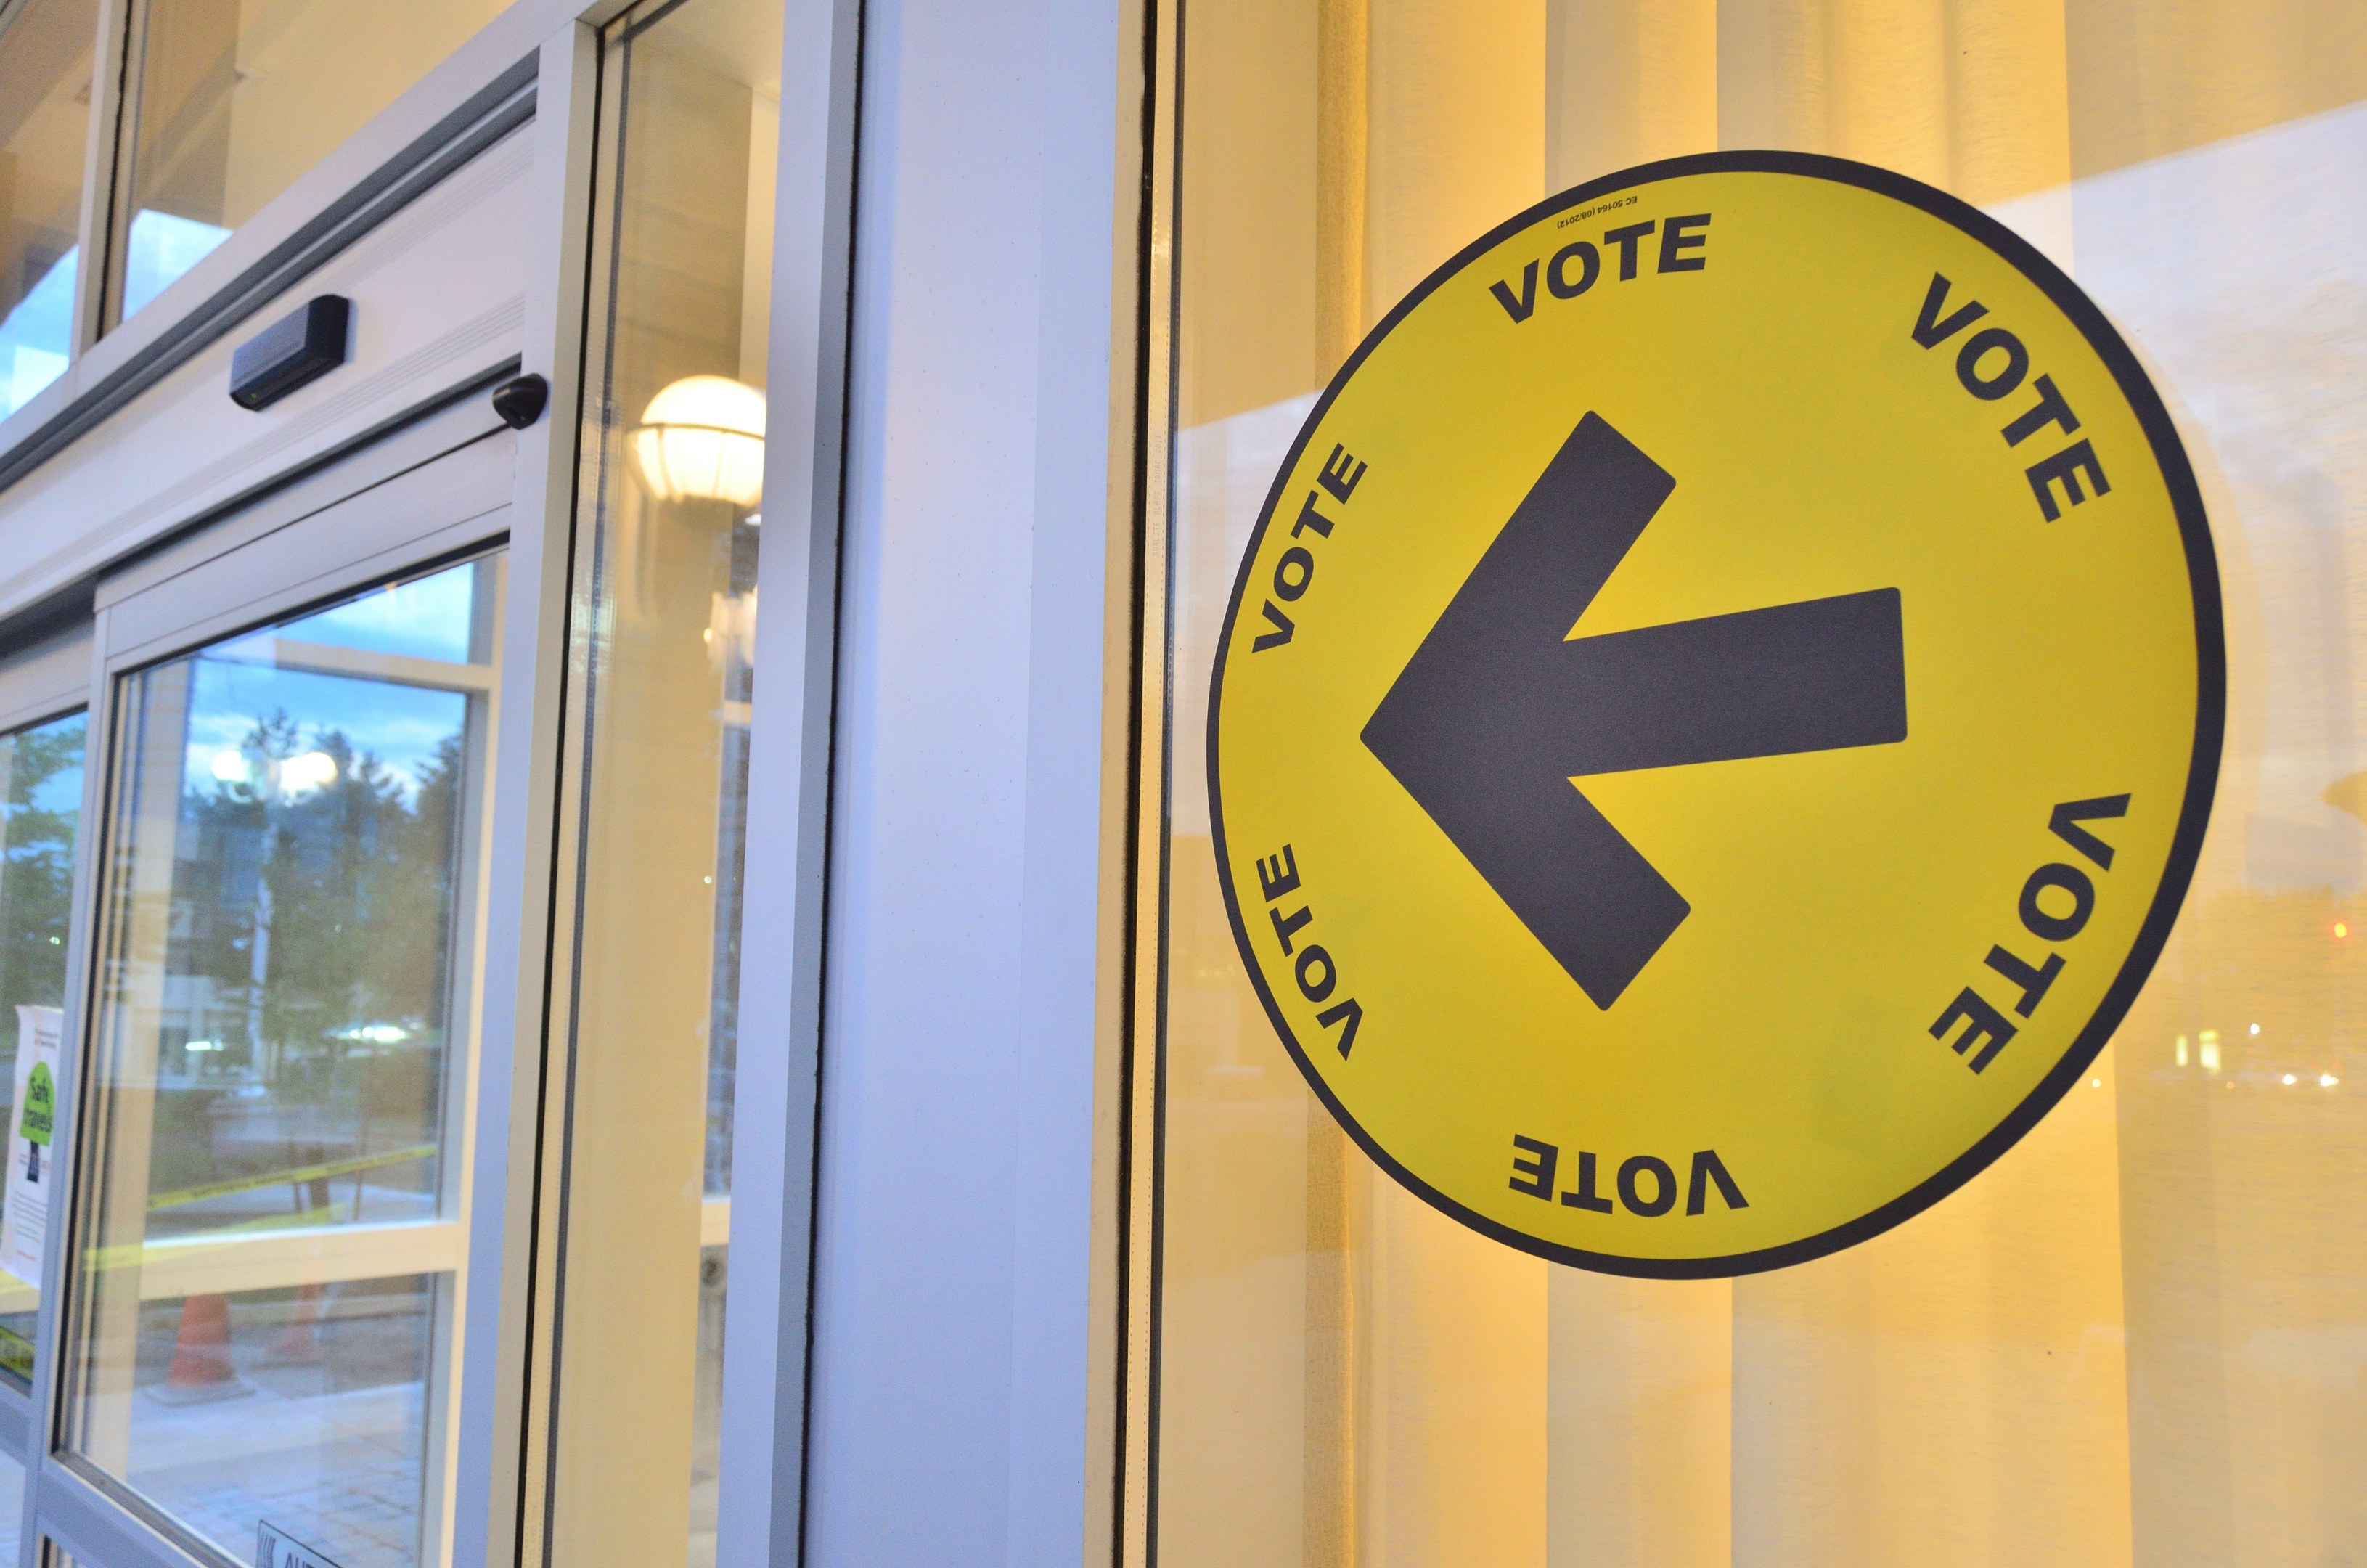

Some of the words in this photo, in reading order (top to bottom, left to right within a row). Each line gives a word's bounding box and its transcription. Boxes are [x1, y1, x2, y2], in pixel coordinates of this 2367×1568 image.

[1557, 206, 1595, 229] (08/2012)
[1597, 200, 1623, 214] 50164
[1625, 196, 1638, 205] EC
[1489, 213, 1711, 324] VOTE
[1912, 272, 2111, 523] VOTE
[1252, 444, 1368, 653] VOTE
[1256, 844, 1362, 1061] VOTE
[1929, 793, 2131, 1074] VOTE
[1509, 1134, 1749, 1217] VOTE
